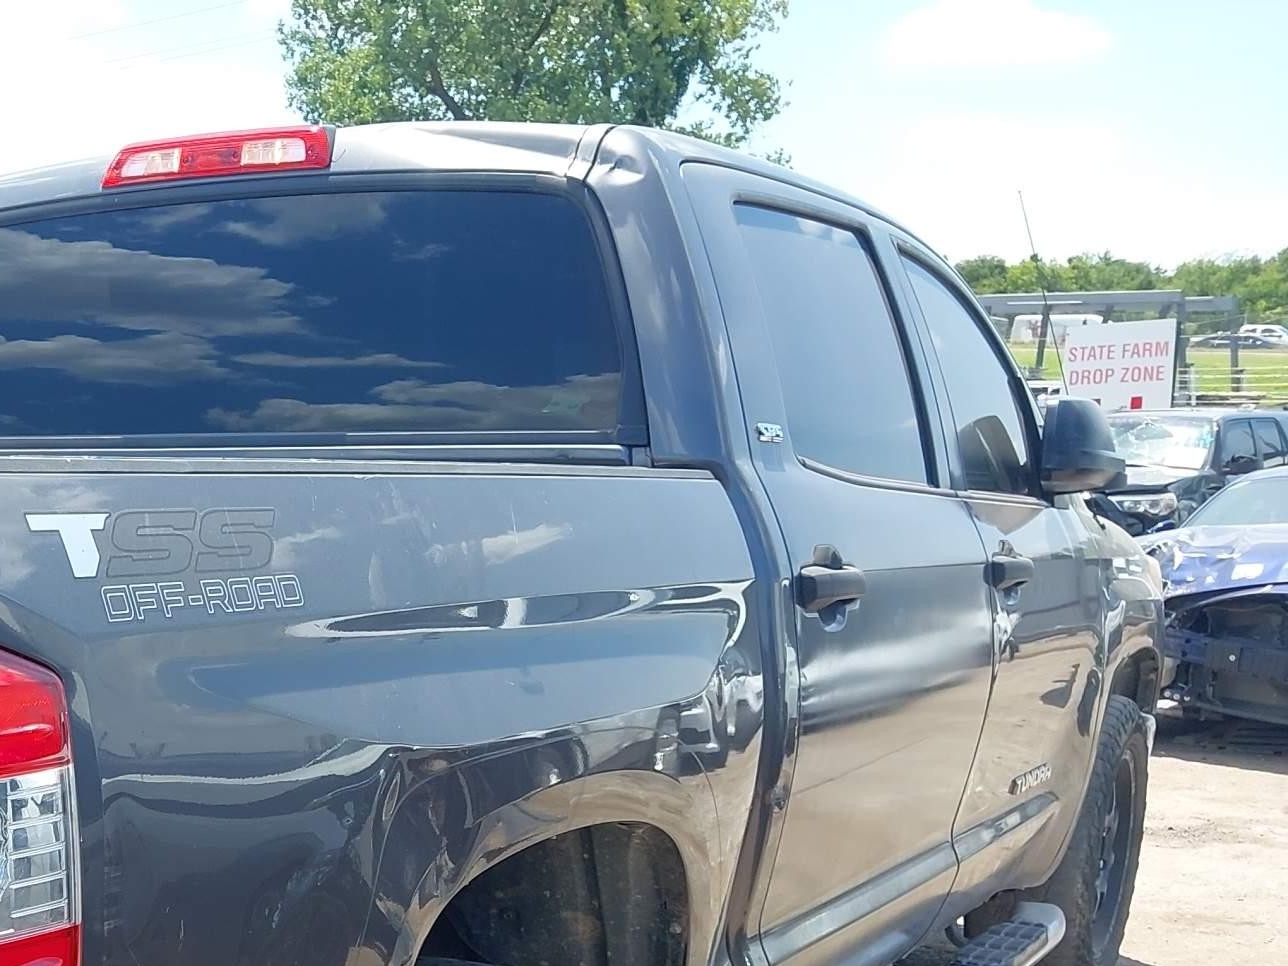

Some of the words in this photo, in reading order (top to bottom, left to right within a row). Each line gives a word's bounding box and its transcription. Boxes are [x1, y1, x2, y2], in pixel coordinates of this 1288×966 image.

[1068, 344, 1115, 362] STATE
[1121, 341, 1169, 359] FARM
[1069, 367, 1114, 385] DROP
[1120, 365, 1165, 383] ZONE
[101, 574, 306, 623] OFF-ROAD
[1015, 765, 1052, 795] TUNDRA
